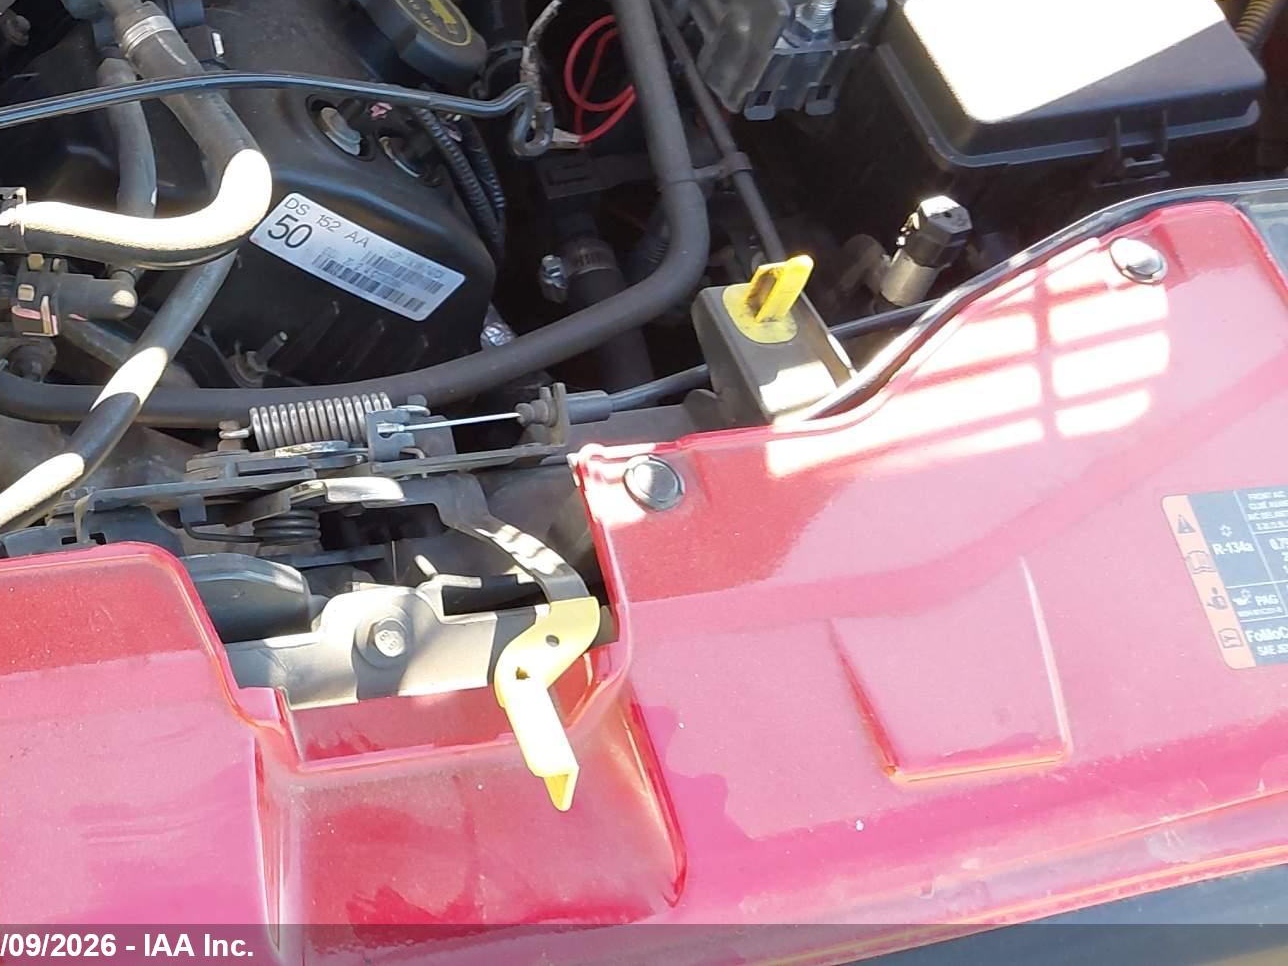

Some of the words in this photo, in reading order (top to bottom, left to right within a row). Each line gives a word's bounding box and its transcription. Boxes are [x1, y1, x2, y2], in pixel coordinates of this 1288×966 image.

[267, 213, 313, 248] 50
[284, 197, 311, 216] DS
[315, 214, 342, 232] 152
[344, 230, 370, 248] AA
[1213, 541, 1255, 555] R-134a
